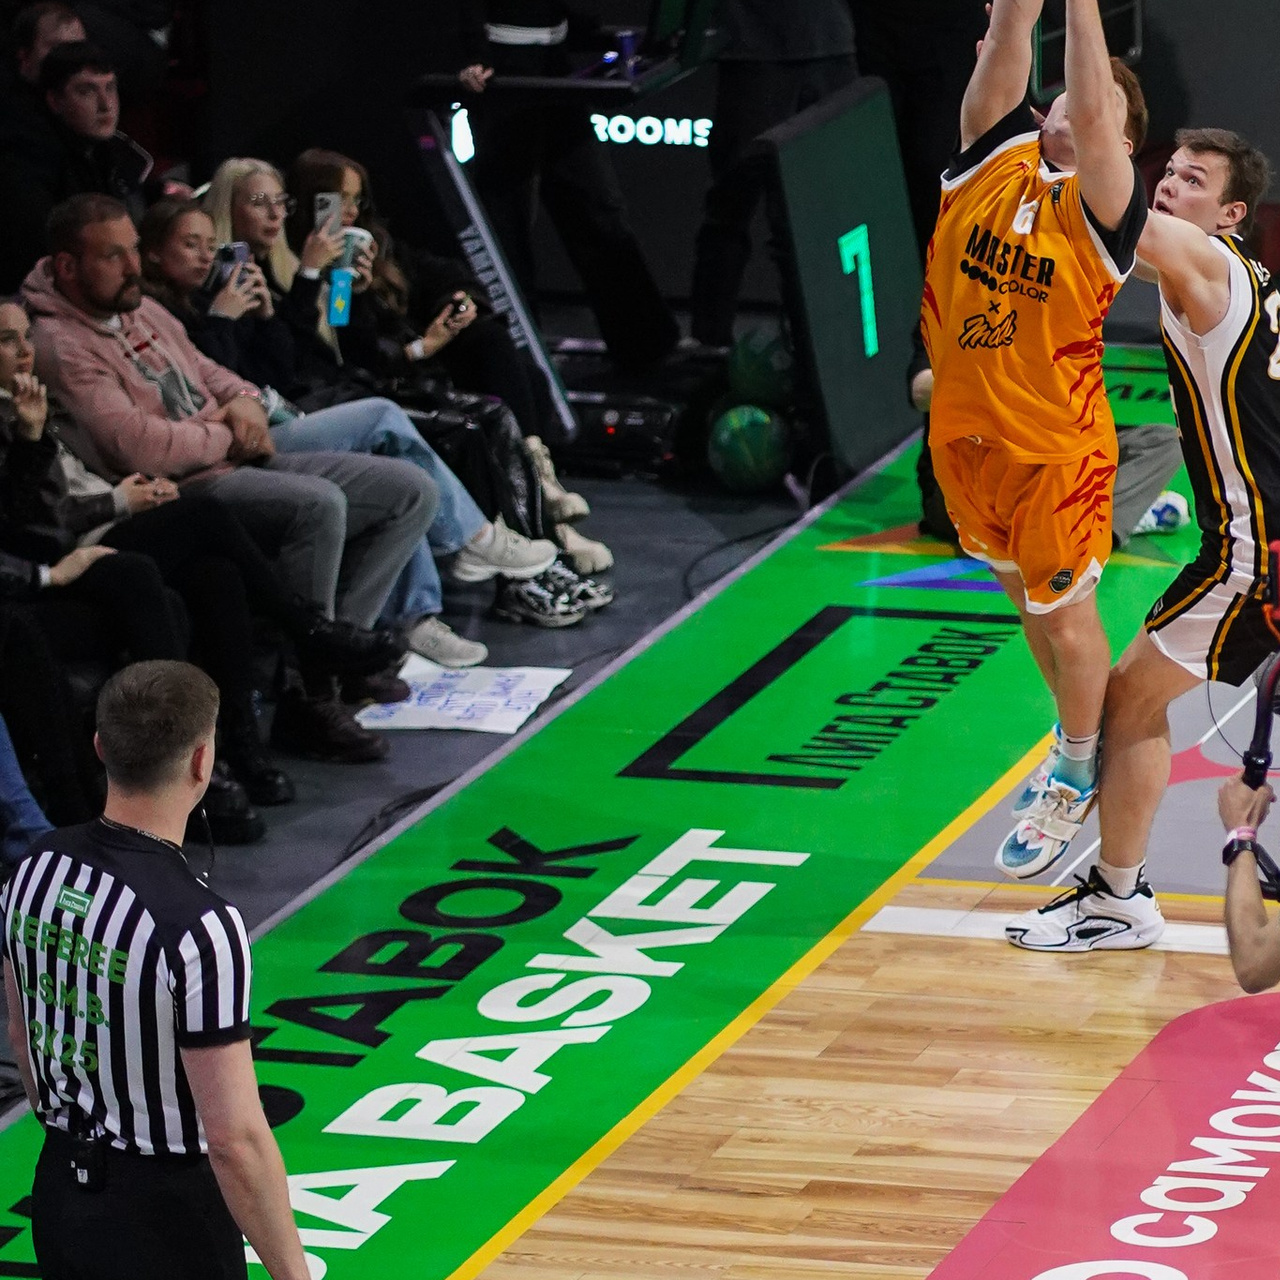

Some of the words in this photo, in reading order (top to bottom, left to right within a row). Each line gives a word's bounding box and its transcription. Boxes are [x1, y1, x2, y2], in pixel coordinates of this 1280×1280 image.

[998, 279, 1049, 304] COLOR
[10, 908, 130, 985] REFEREE
[321, 827, 812, 1145] BASKET
